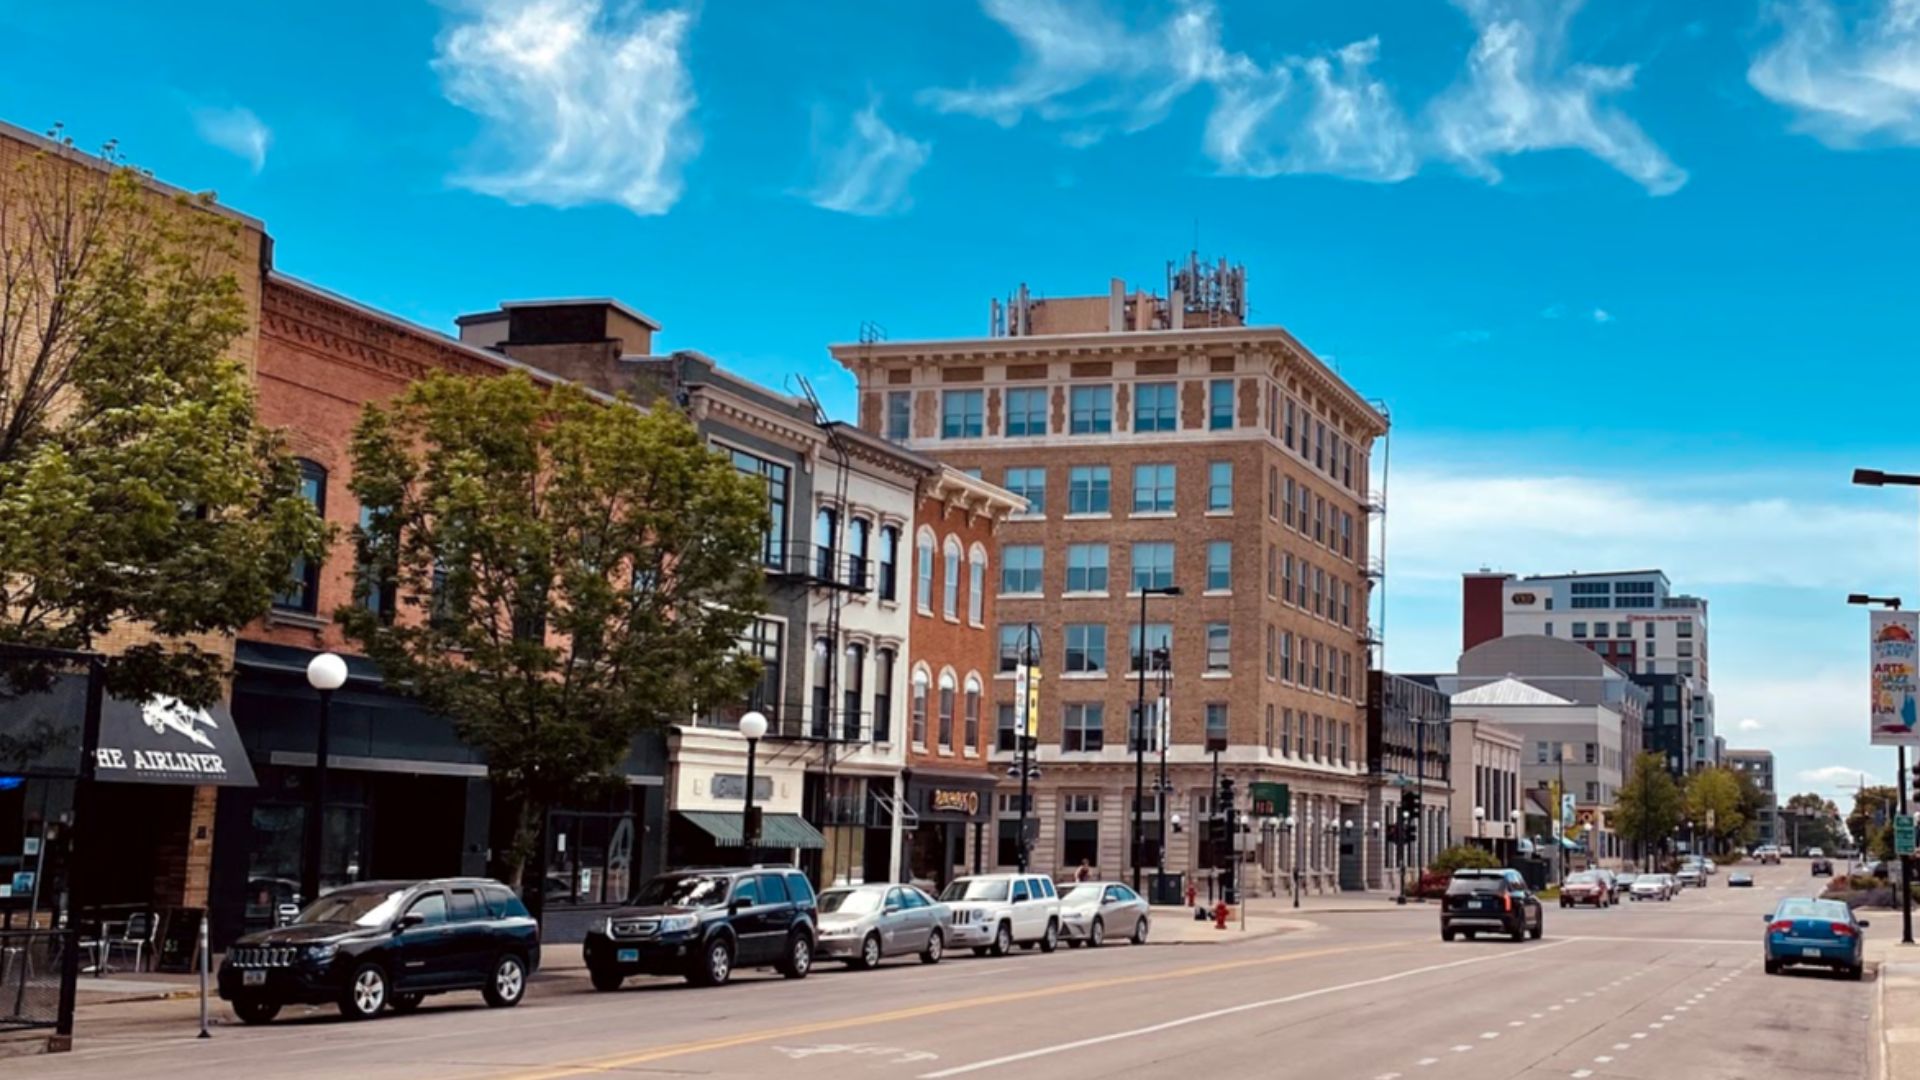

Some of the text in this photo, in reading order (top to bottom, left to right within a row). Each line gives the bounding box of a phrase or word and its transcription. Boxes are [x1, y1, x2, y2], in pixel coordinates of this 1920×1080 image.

[1874, 663, 1905, 672] ARTS
[94, 747, 227, 773] HE AIRLINER
